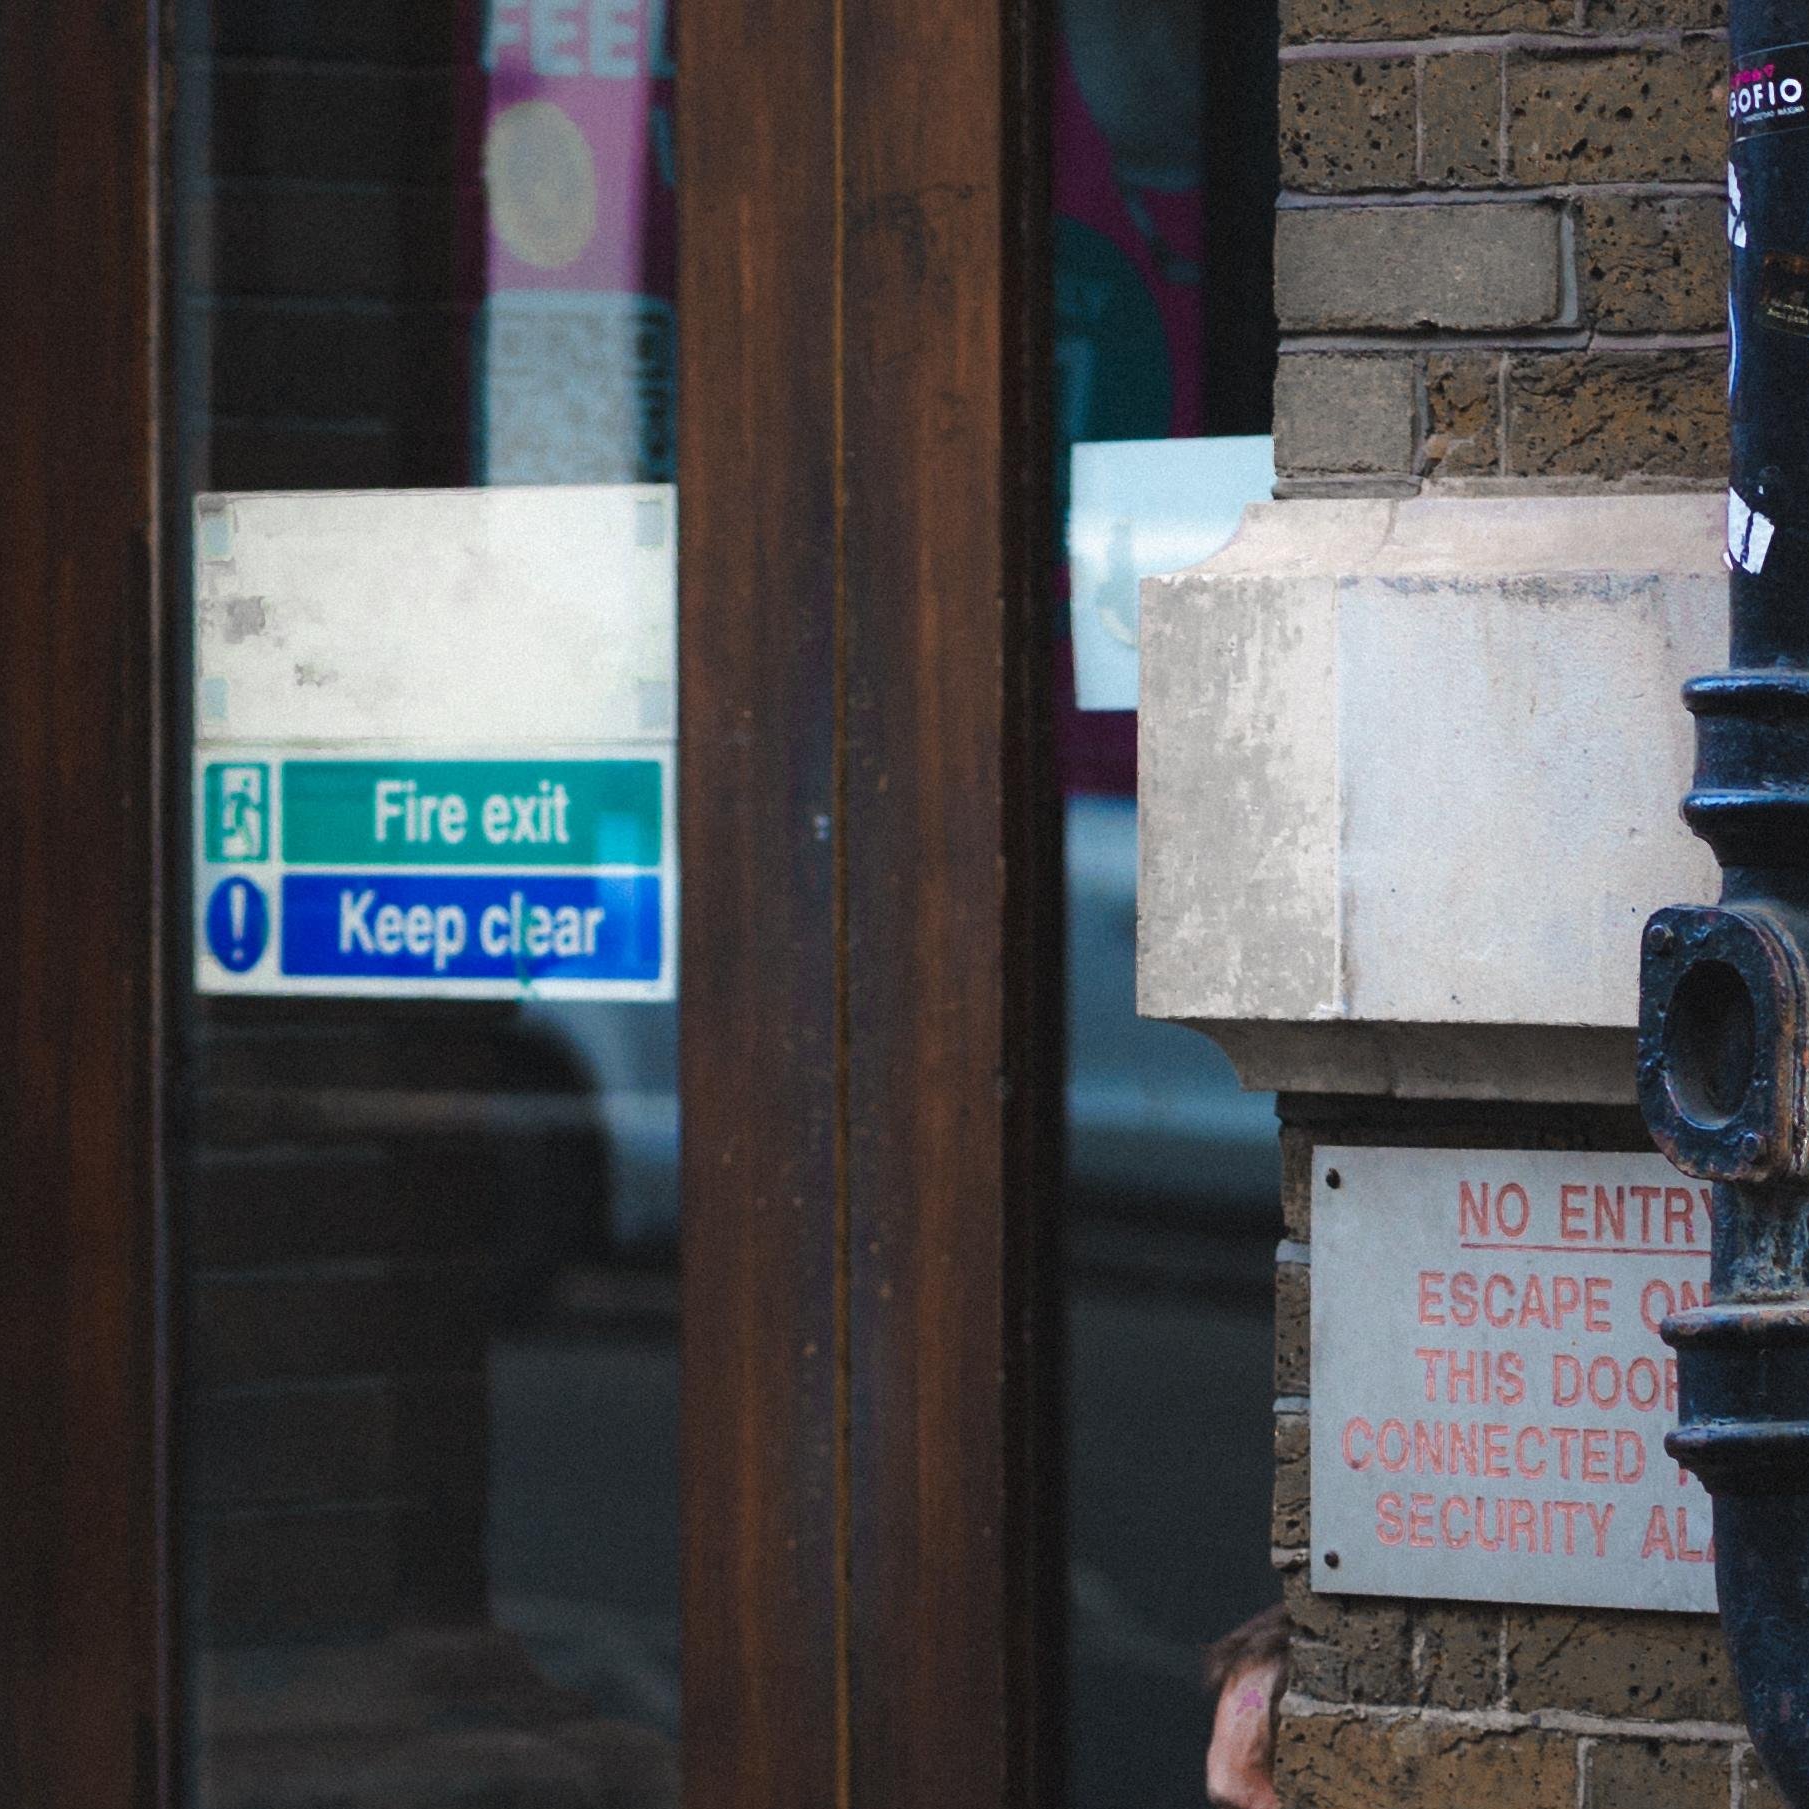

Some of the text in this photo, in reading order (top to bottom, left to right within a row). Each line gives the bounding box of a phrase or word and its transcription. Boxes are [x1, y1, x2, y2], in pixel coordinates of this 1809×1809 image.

[375, 780, 570, 844] Fire exit
[340, 890, 605, 970] Keep clear
[1459, 1180, 1530, 1239] NO
[1417, 1271, 1613, 1333] ESCAPE
[1415, 1348, 1526, 1406] THIS
[1342, 1416, 1646, 1484] CONNECTED
[1375, 1491, 1615, 1557] SECURITY
